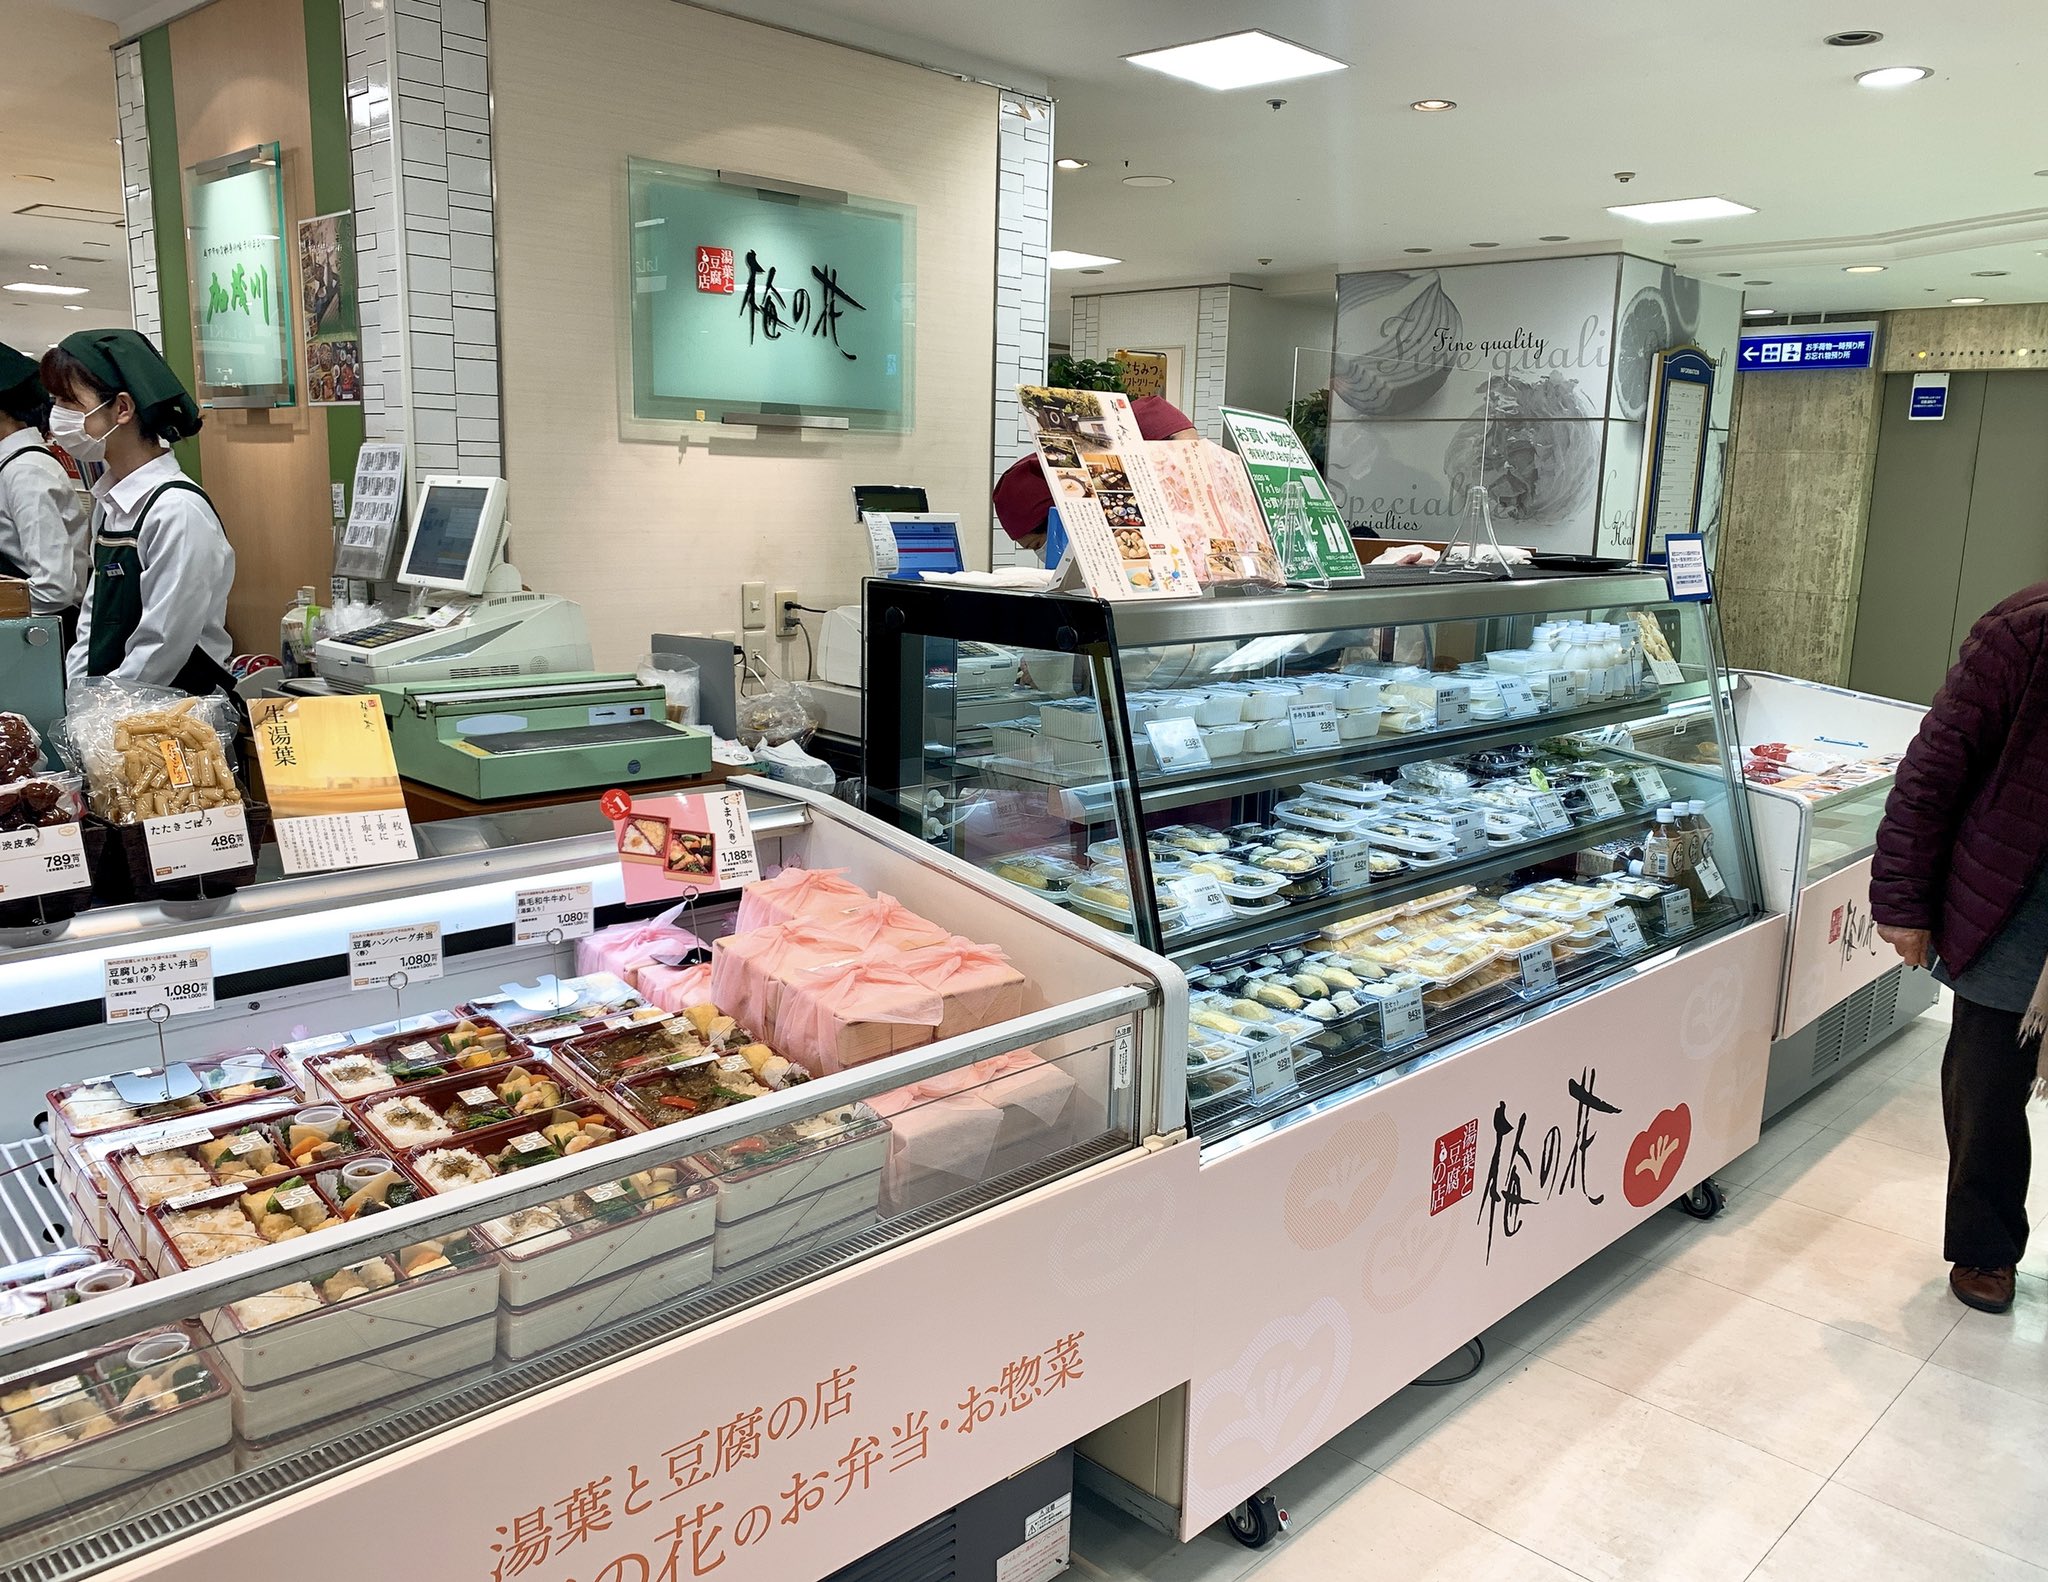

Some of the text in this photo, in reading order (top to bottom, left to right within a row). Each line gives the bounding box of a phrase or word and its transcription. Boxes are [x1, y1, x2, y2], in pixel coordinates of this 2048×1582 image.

[698, 260, 710, 290] の店
[710, 254, 722, 286] 豆腐
[721, 249, 734, 293] 湯葉と
[739, 249, 867, 360] 梅の花
[1433, 326, 1549, 360] Fine quality
[1343, 510, 1421, 531] pecialties
[264, 704, 297, 767] 生湯葉
[150, 817, 213, 836] たたきごぼう
[518, 893, 575, 907] 黒毛和牛牛めし
[352, 931, 434, 950] 豆腐ハンバーグ弁当
[109, 958, 199, 978] 豆腐しゅうまい弁当
[1447, 1139, 1463, 1196] 豆腐
[1461, 1119, 1477, 1197] 湯葉と
[1477, 1066, 1622, 1266] 梅の花
[1431, 1161, 1447, 1212] の店
[490, 1364, 859, 1581] 湯葉と豆腐の店
[566, 1331, 1085, 1582] の花のお弁当・お惣菜
